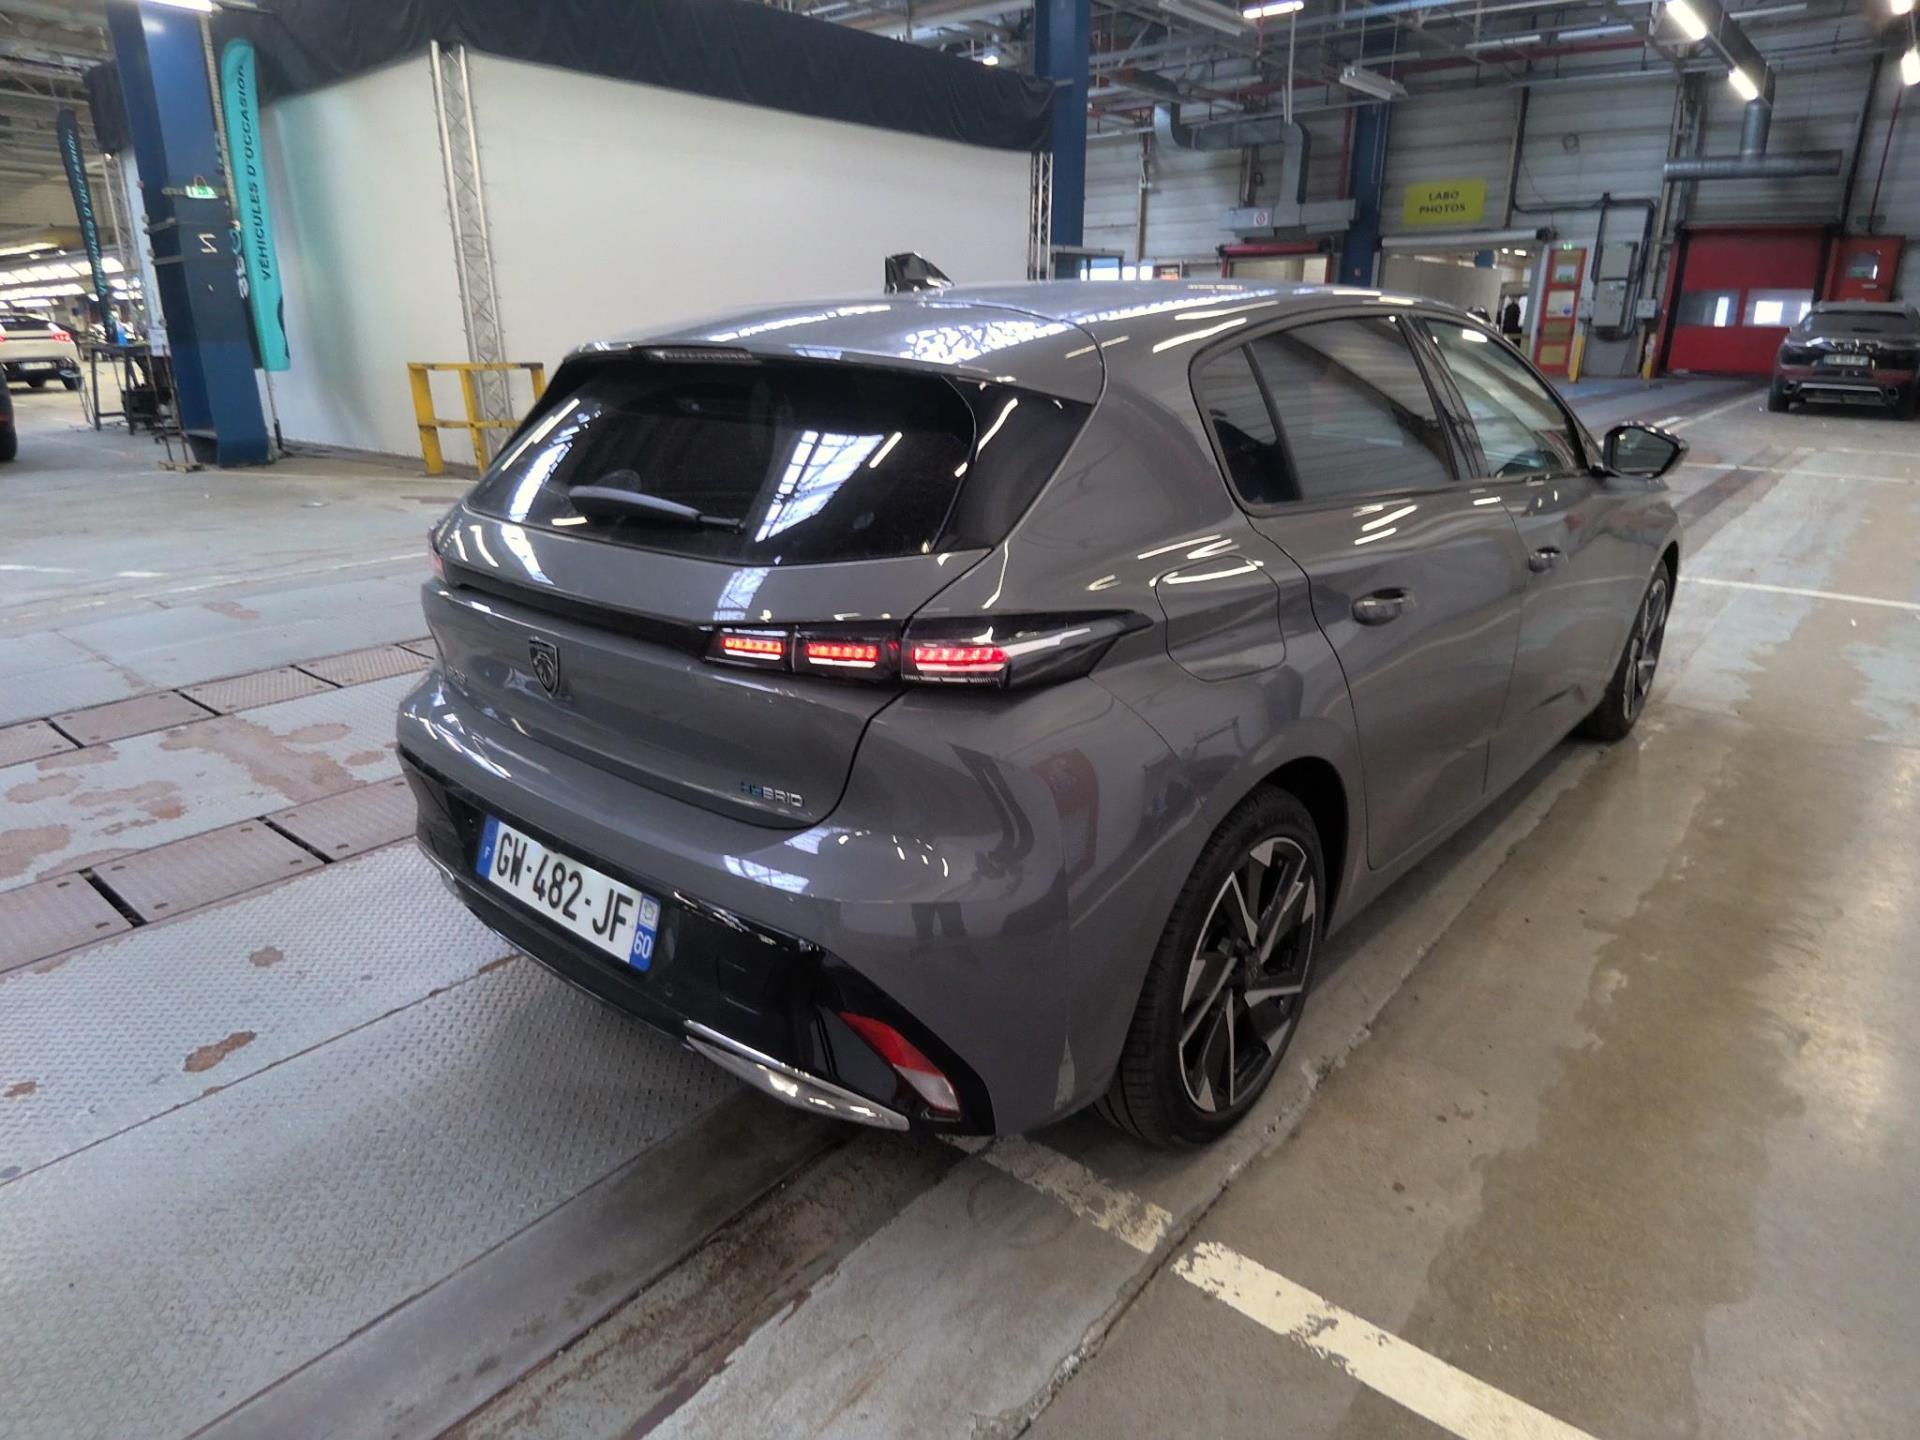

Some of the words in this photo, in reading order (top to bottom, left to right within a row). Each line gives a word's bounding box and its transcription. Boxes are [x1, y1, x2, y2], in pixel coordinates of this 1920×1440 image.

[1428, 190, 1460, 201] LABO
[1419, 203, 1466, 215] PHOTOS
[738, 782, 804, 807] HYBRID
[496, 831, 634, 943] GW-482-JF
[633, 930, 652, 959] 60
